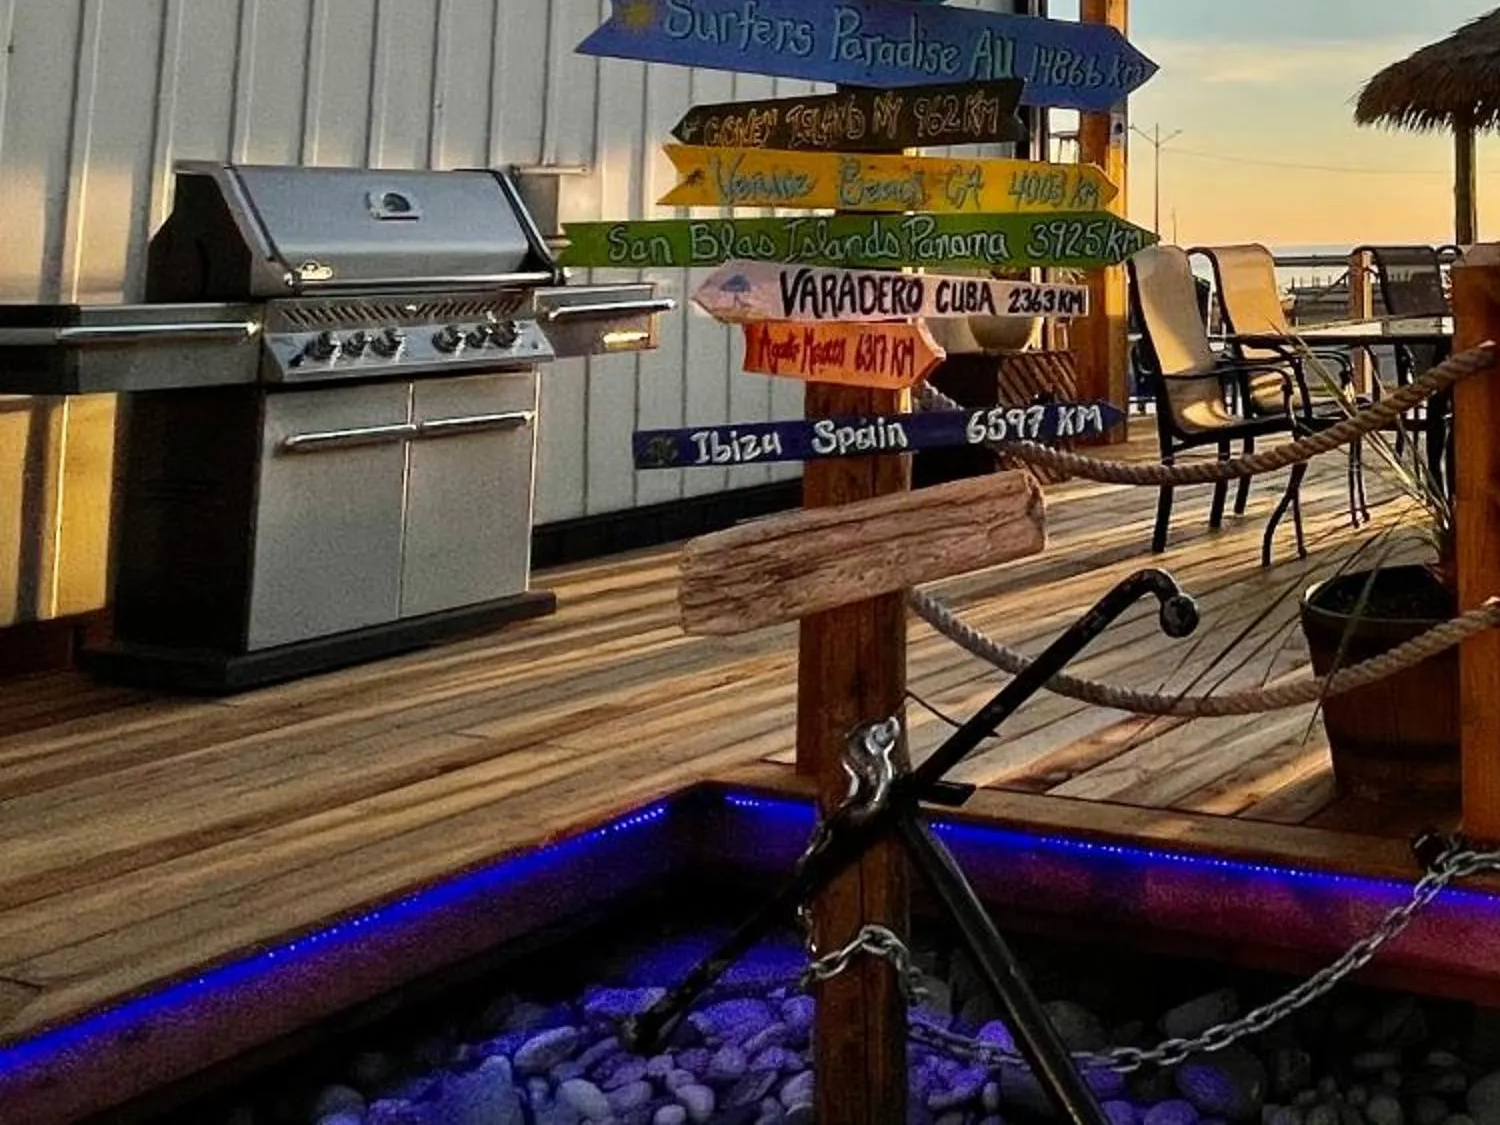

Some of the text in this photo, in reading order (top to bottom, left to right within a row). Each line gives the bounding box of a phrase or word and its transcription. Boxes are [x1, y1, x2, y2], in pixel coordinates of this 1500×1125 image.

[830, 5, 962, 74] Paradise
[913, 93, 961, 138] 962
[606, 224, 674, 265] San
[689, 221, 778, 263] Blas
[784, 218, 900, 262] Islands
[902, 215, 1013, 264] Panama
[1026, 222, 1104, 260] 3925
[779, 268, 1086, 320] VARADERO CUBA 2363 KM
[689, 403, 1103, 464] Ibiza Spain 6597 KM
